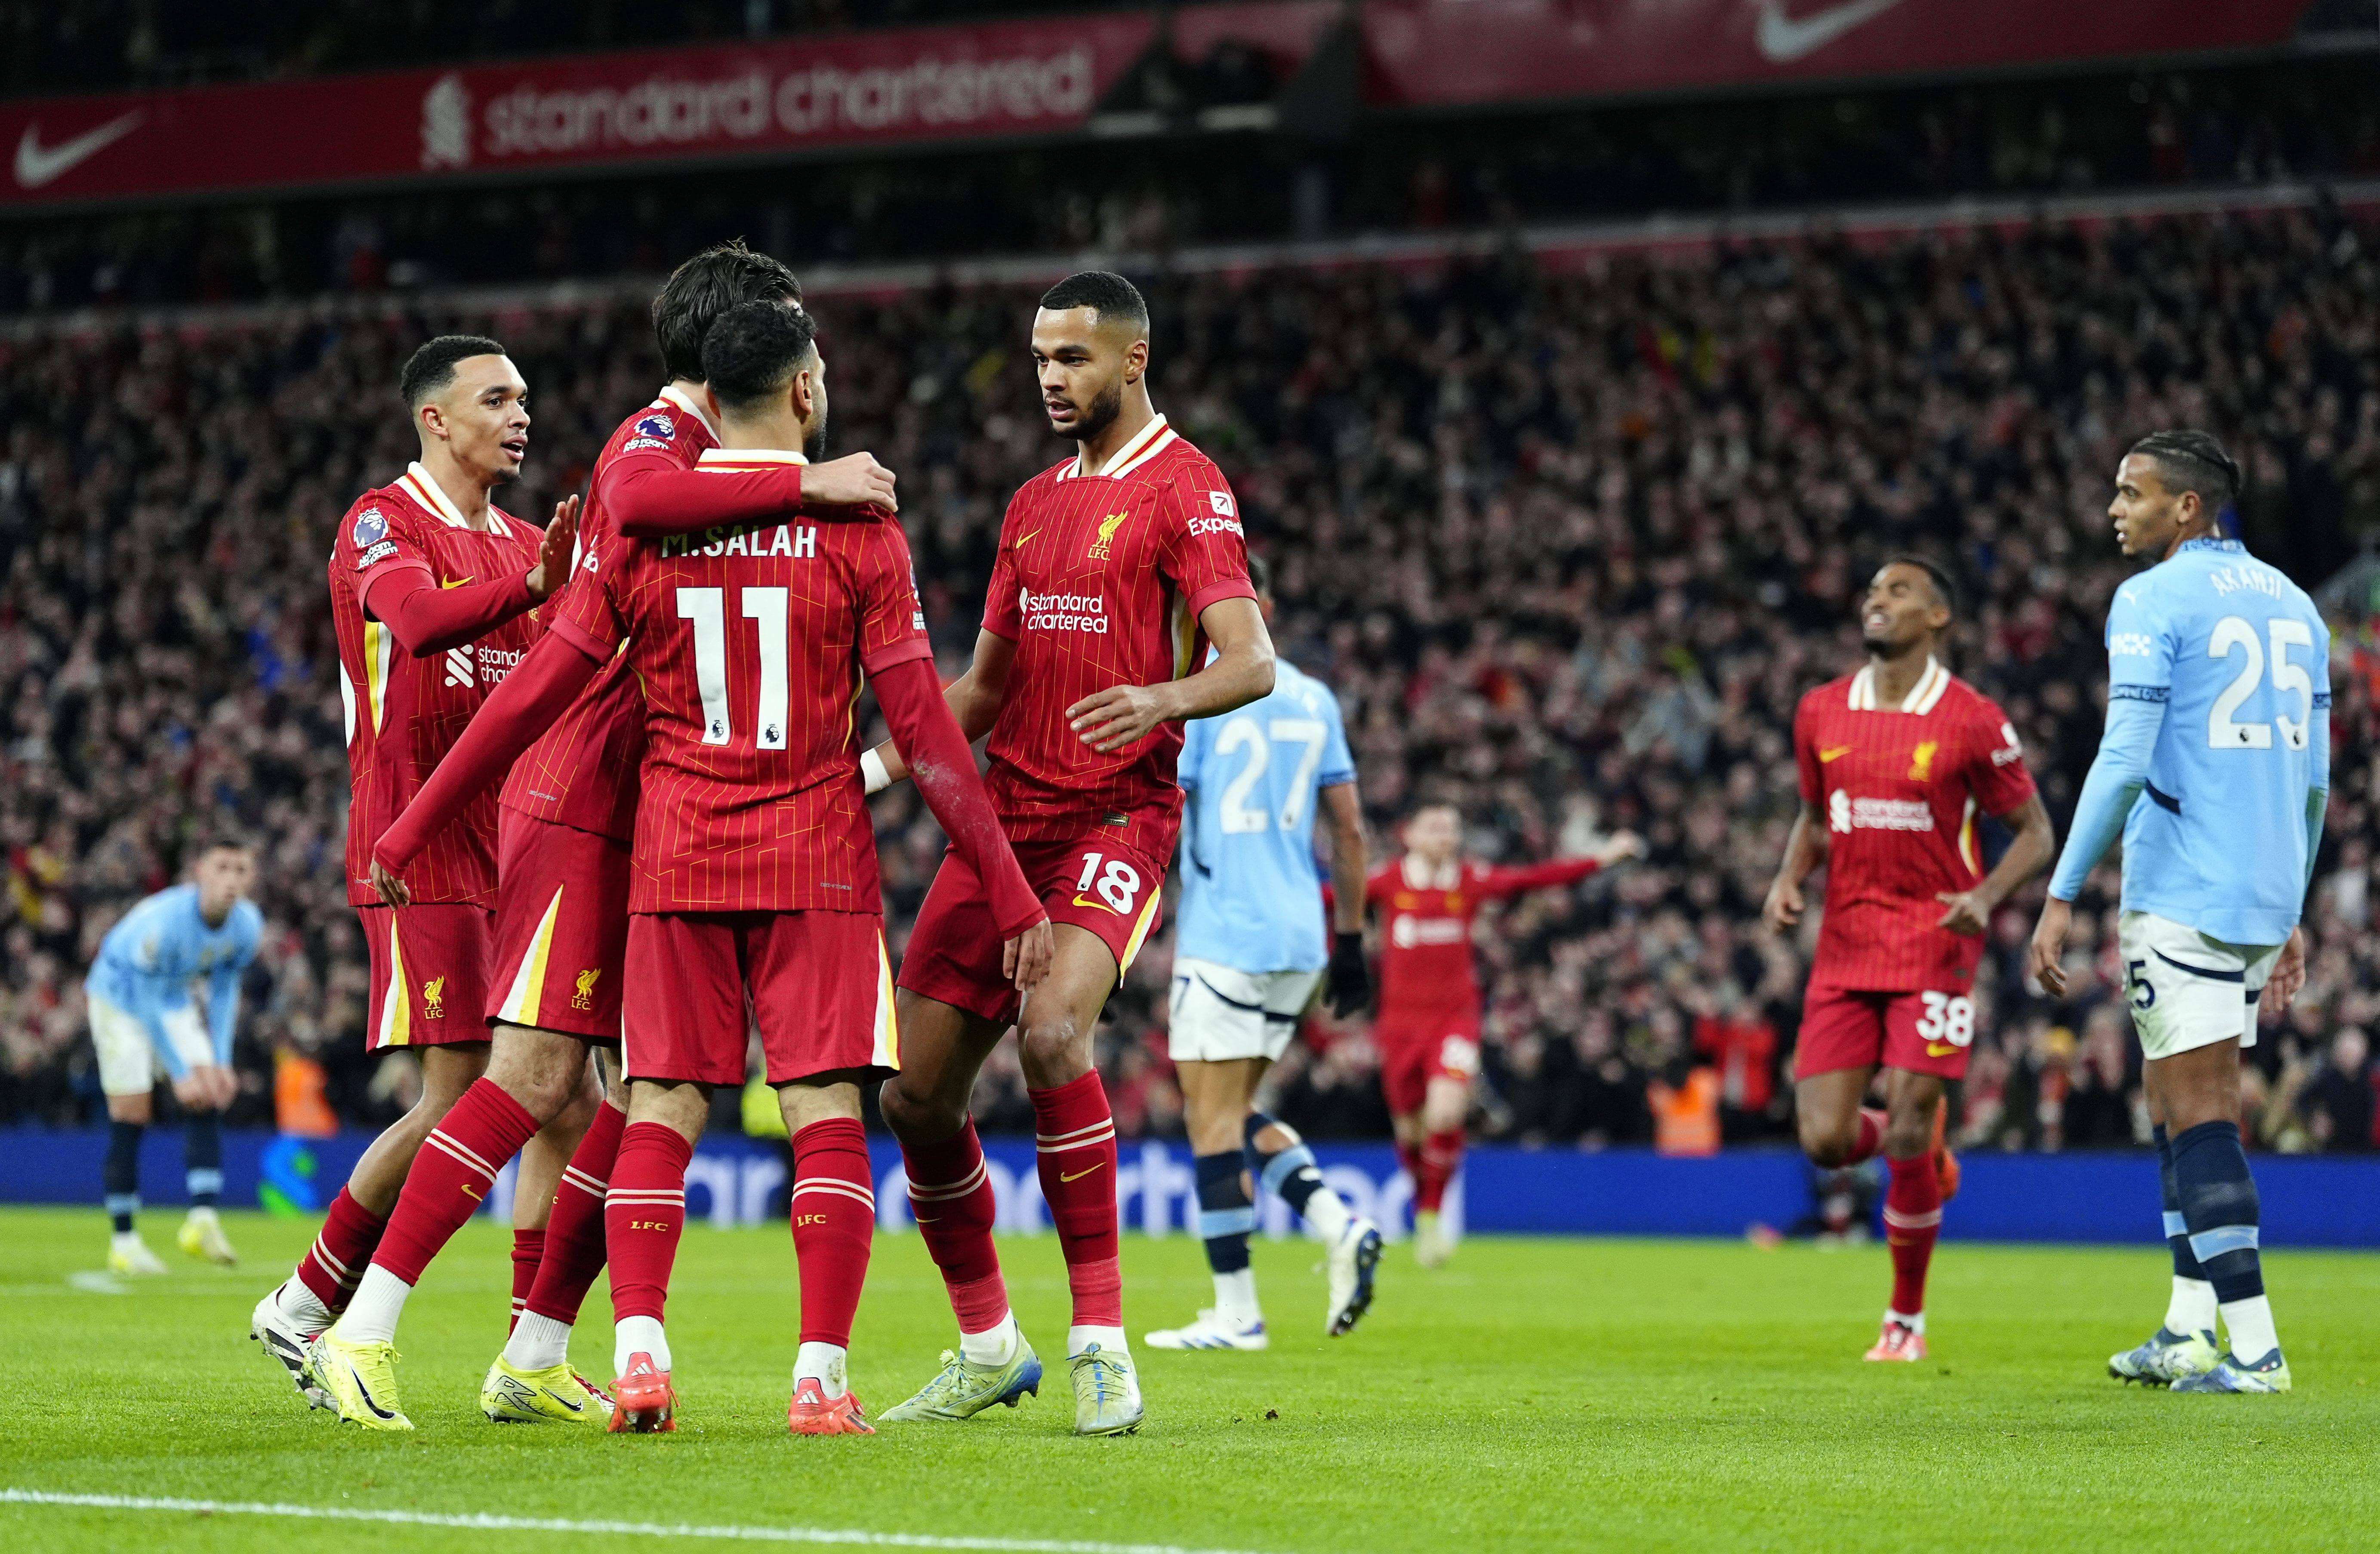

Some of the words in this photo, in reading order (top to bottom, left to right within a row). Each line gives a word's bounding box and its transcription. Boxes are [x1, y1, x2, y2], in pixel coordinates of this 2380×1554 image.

[485, 69, 772, 155] standard
[776, 48, 1094, 133] chartered
[1028, 611, 1108, 634] chartered
[1030, 591, 1103, 613] standard
[676, 587, 789, 750] 11
[2207, 615, 2313, 751] 25
[1214, 715, 1328, 834] 27
[1076, 853, 1140, 914] 18
[2130, 960, 2155, 1009] 5
[1916, 990, 1976, 1047] 38
[630, 1221, 668, 1231] LFC
[797, 1214, 826, 1227] LFC
